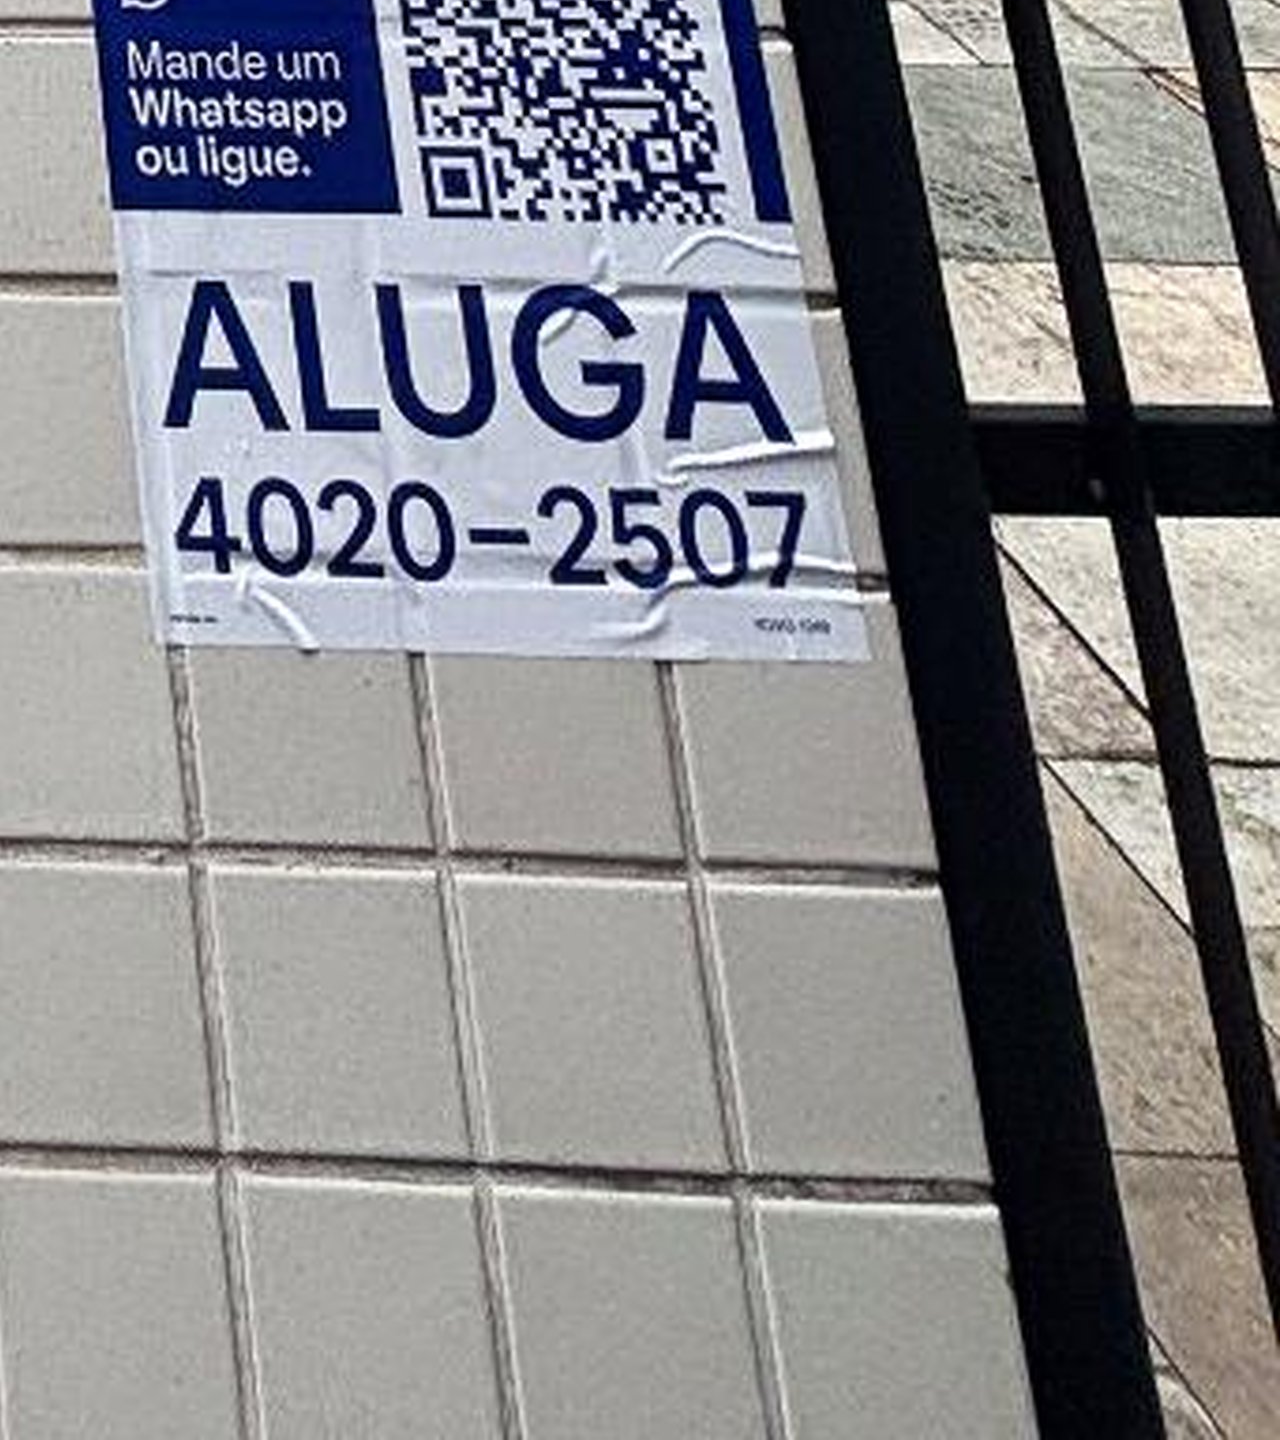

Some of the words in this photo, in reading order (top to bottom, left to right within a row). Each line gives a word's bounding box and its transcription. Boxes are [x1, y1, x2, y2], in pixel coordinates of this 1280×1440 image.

[127, 39, 268, 80] Mande
[276, 51, 342, 80] um
[127, 87, 349, 138] Whatsapp
[135, 145, 189, 177] ou
[196, 134, 313, 187] ligue.
[162, 279, 796, 445] ALUGA
[174, 477, 807, 589] 4020-2507
